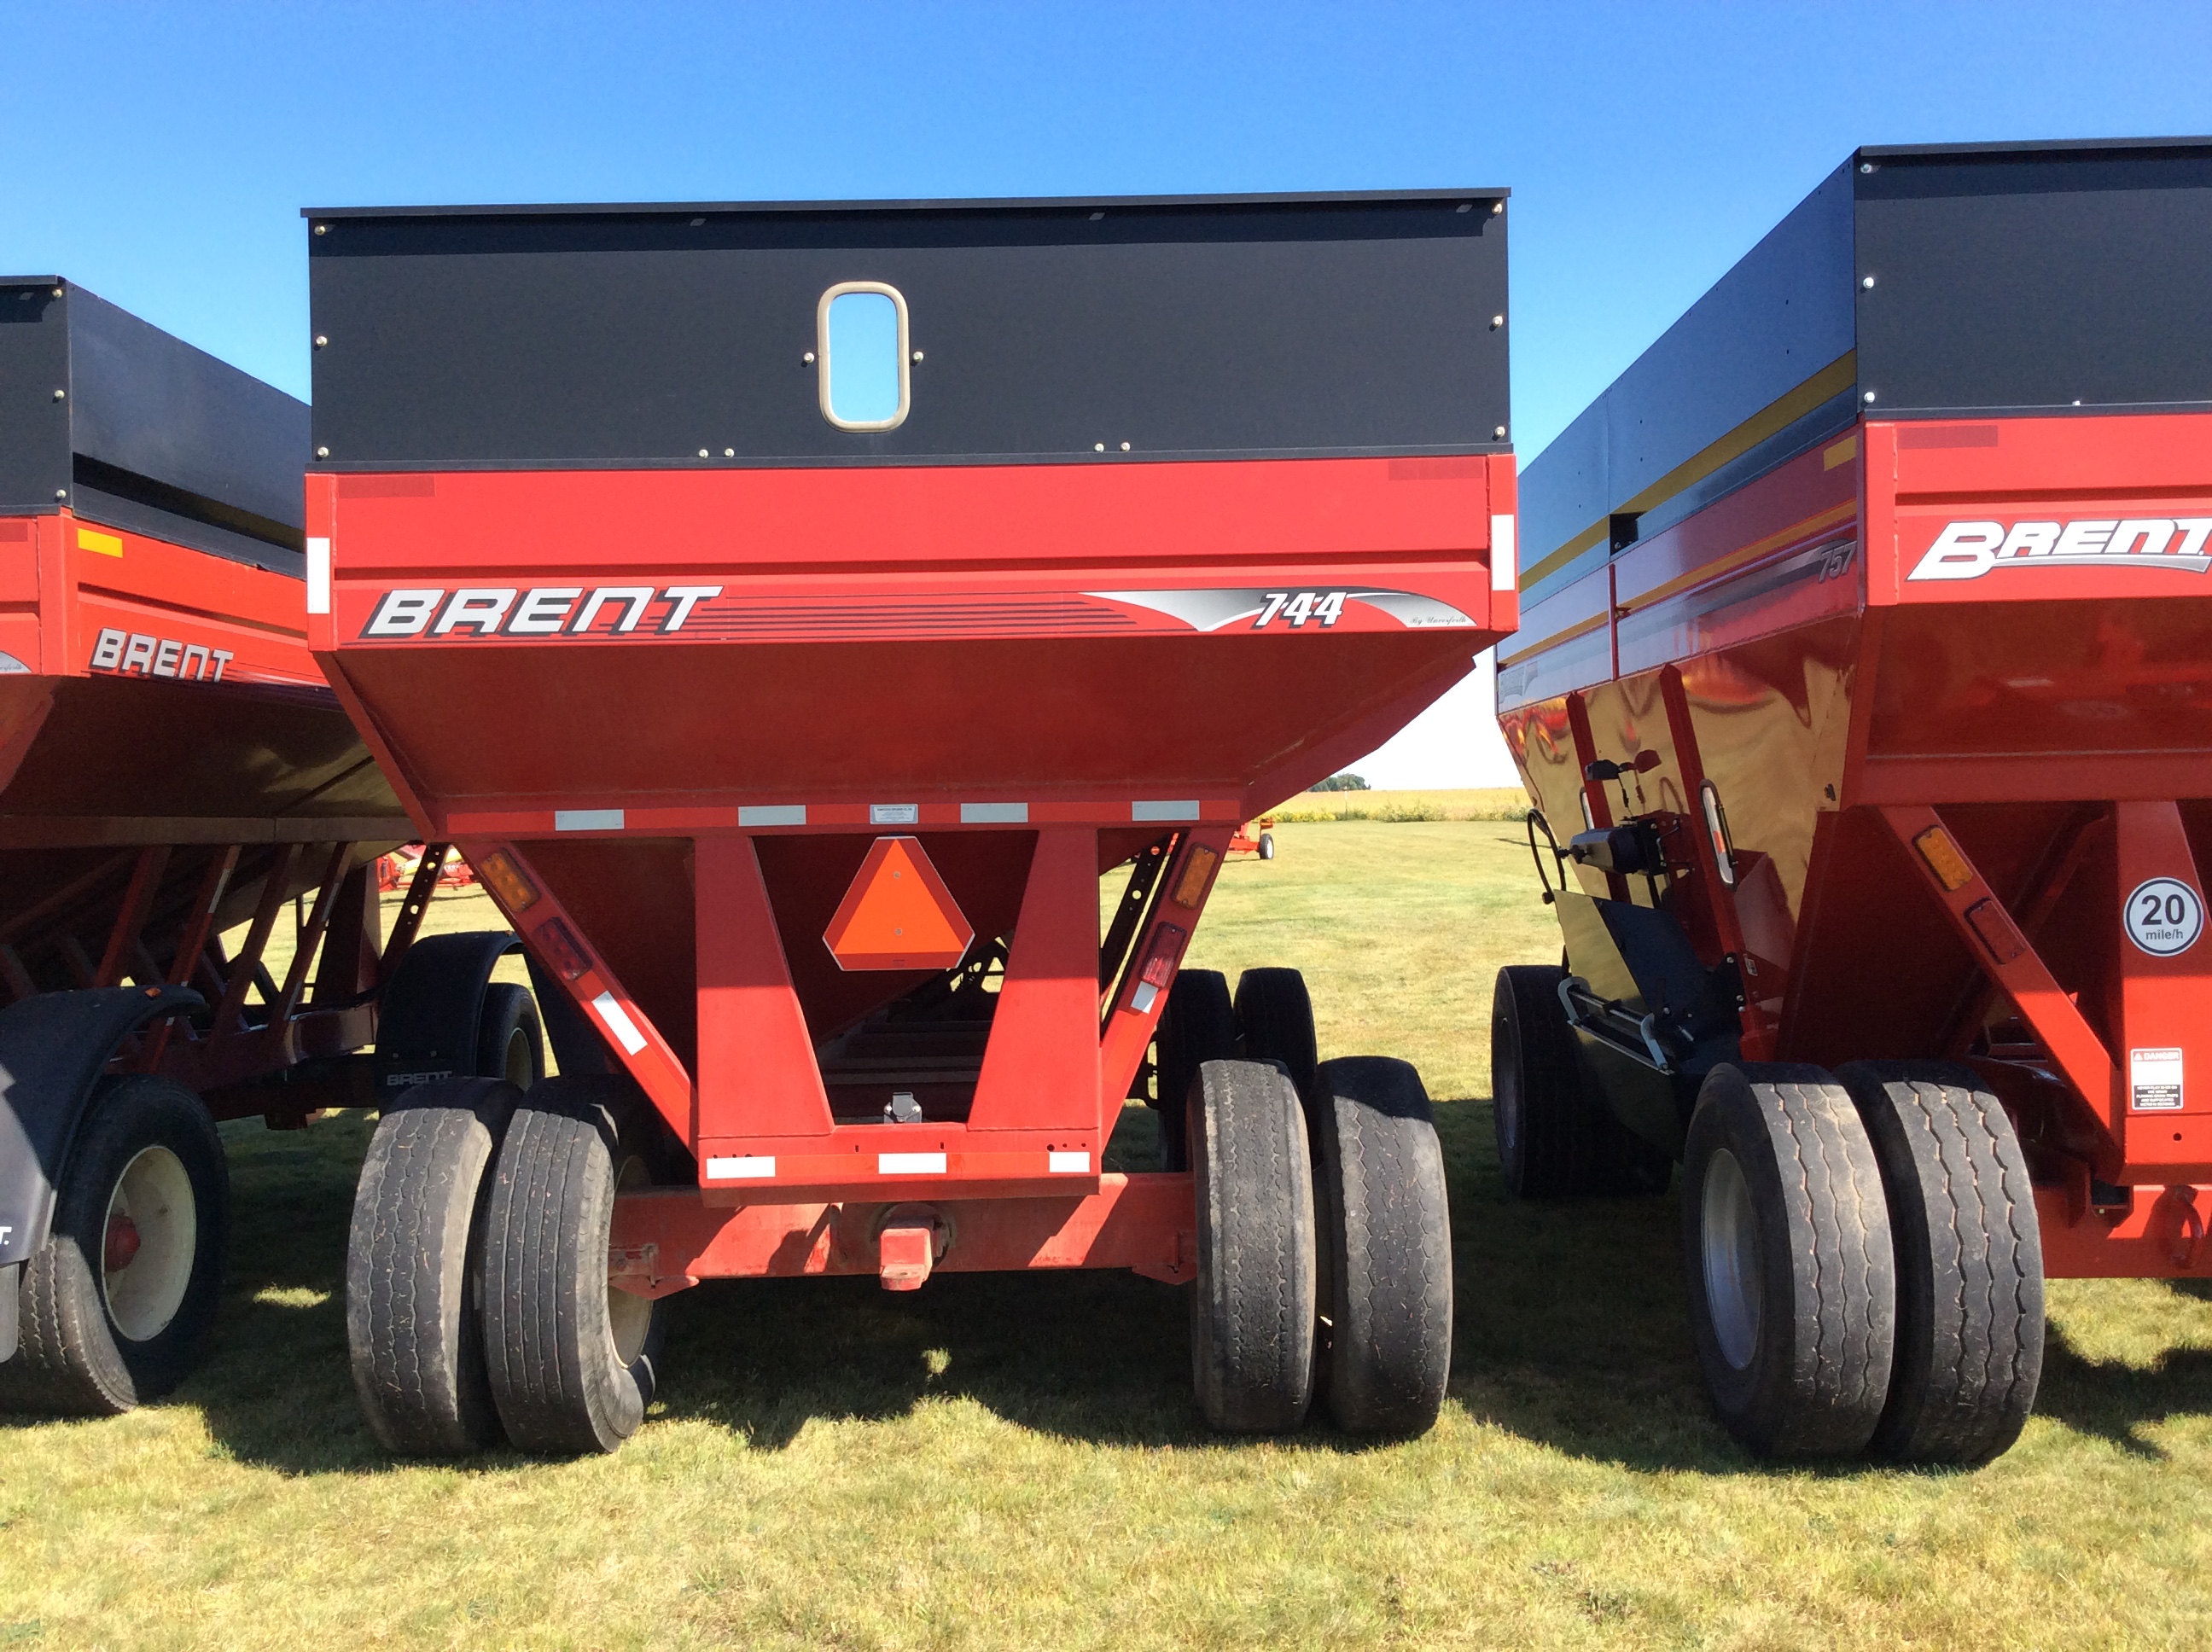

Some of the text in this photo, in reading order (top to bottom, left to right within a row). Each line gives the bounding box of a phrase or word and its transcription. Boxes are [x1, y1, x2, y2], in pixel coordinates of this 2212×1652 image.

[1819, 540, 1857, 584] 757
[1905, 516, 2212, 581] BRENT
[359, 585, 724, 637] BRENT
[1250, 591, 1348, 630] 744
[90, 627, 235, 683] BRENT
[2141, 894, 2185, 926] 20
[2145, 928, 2184, 939] mile/h
[2144, 1051, 2179, 1061] DANGER
[387, 1070, 452, 1086] BRENT
